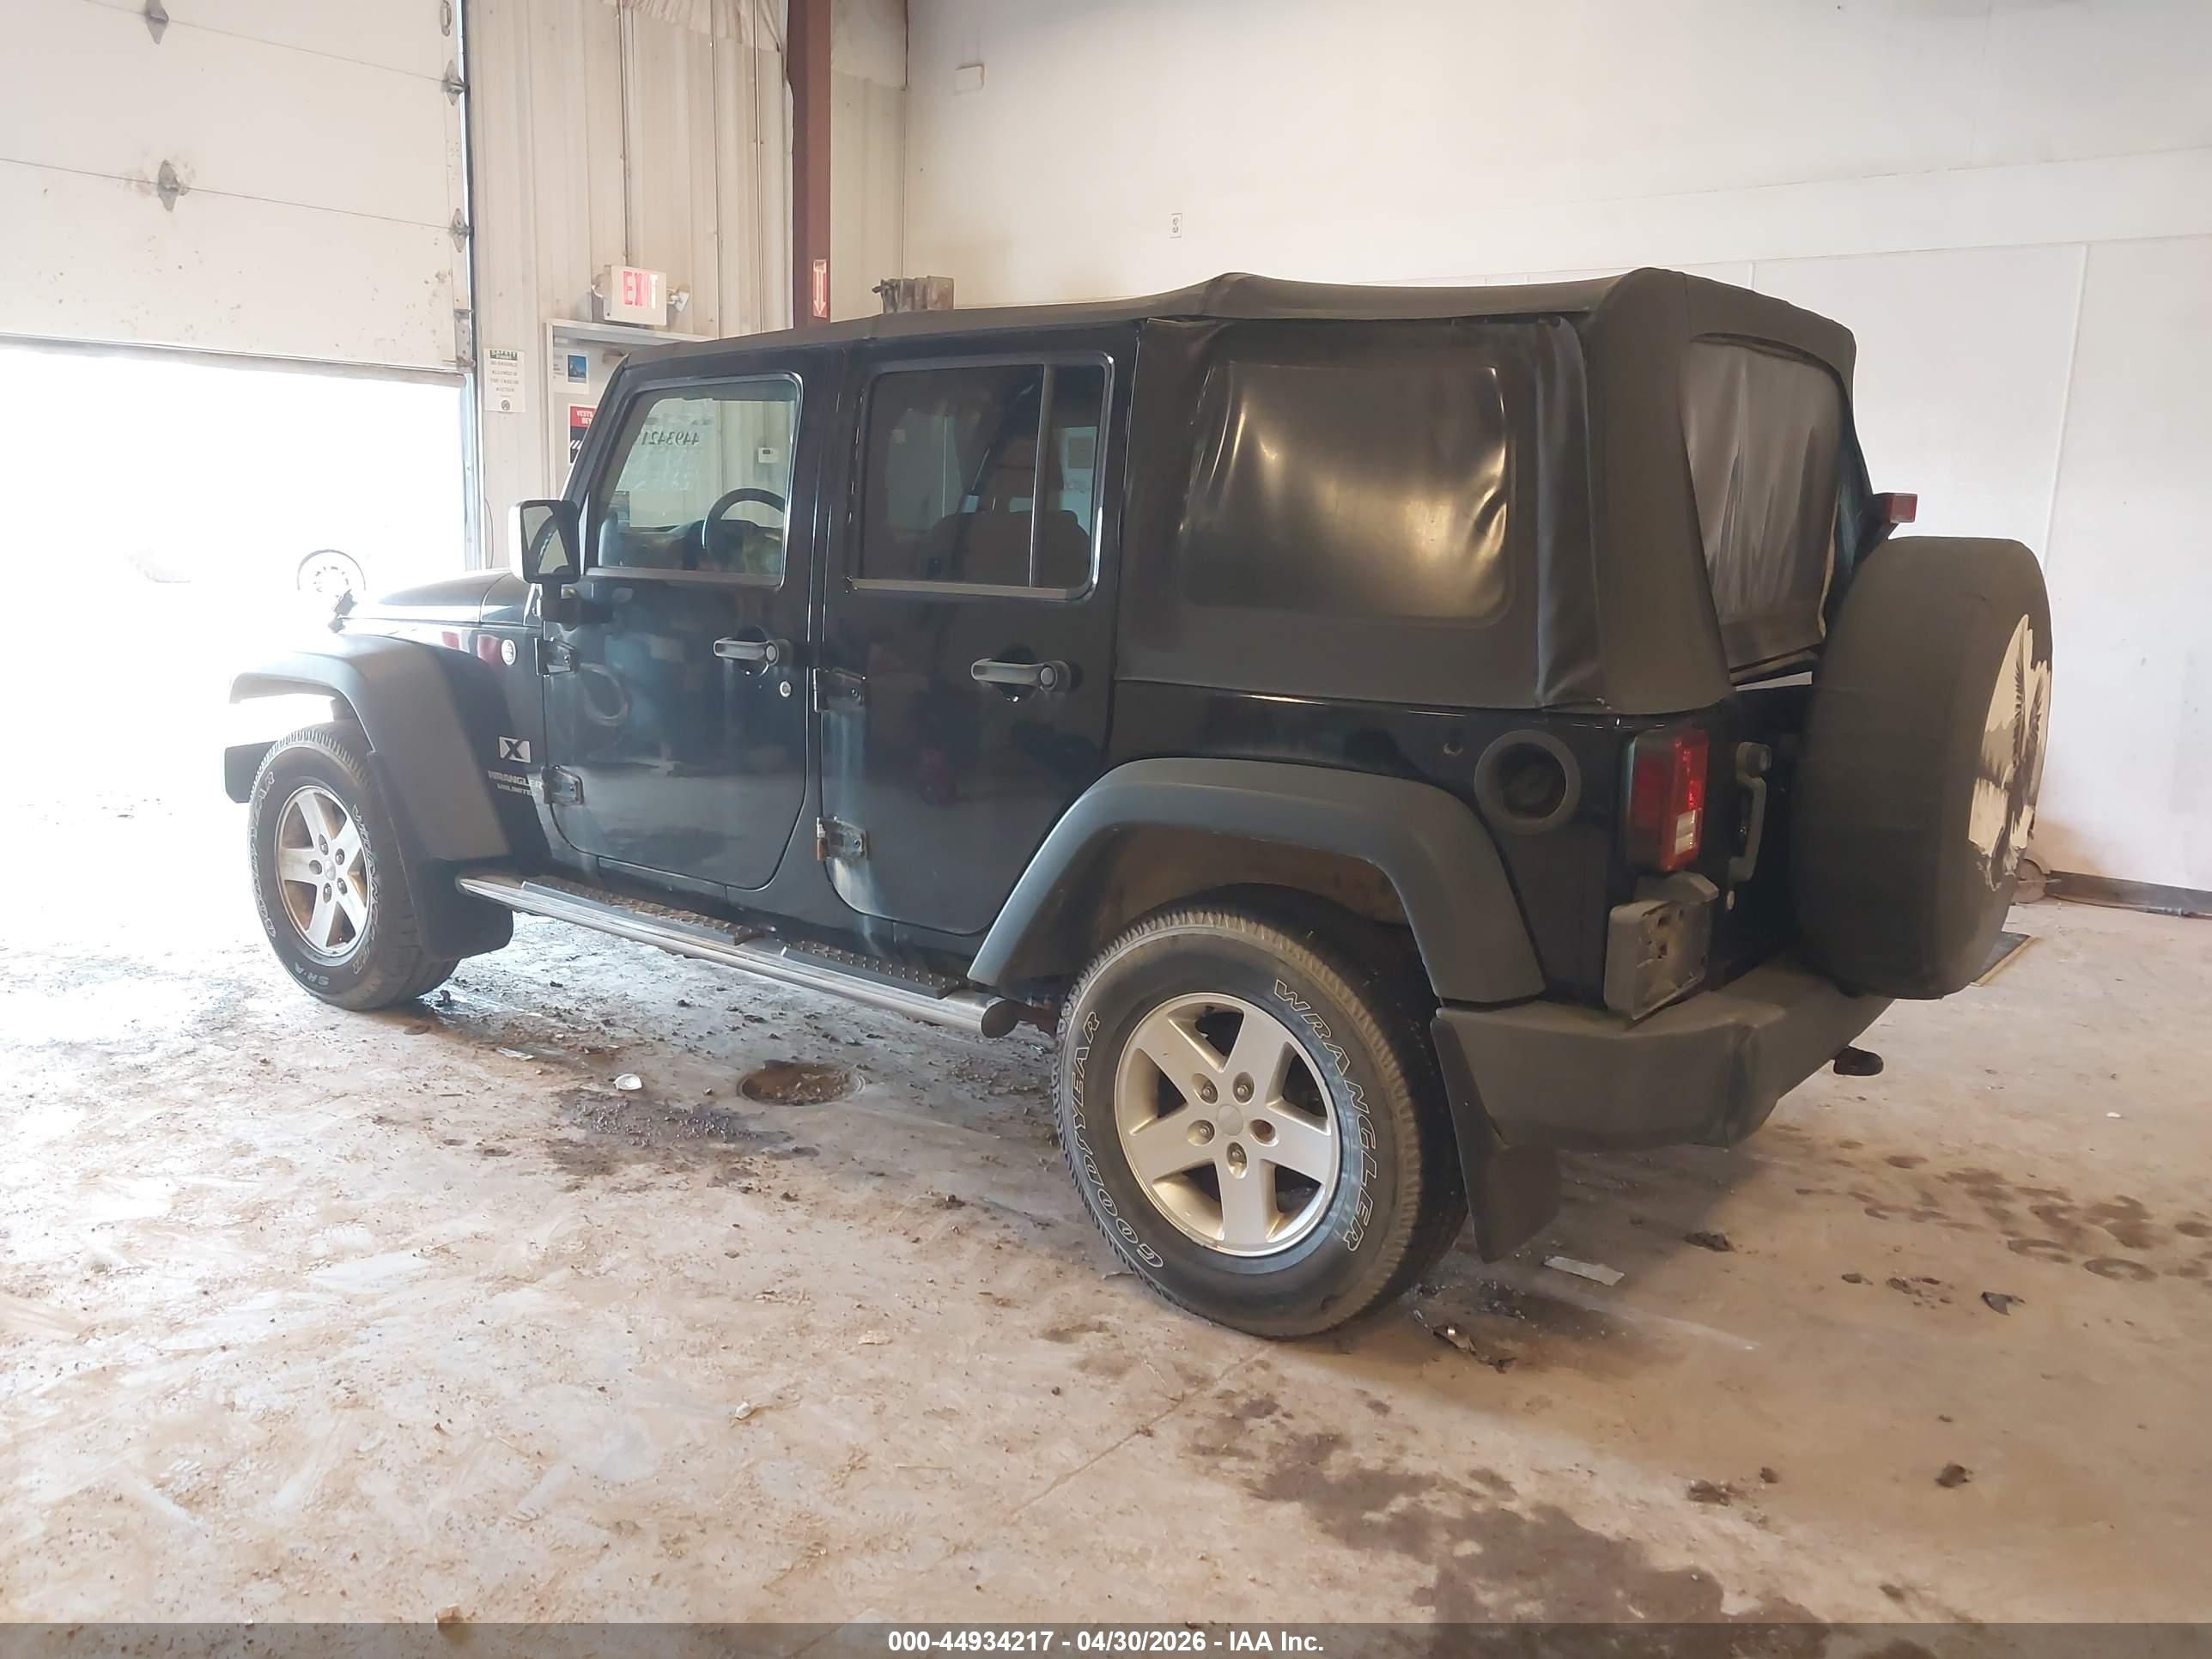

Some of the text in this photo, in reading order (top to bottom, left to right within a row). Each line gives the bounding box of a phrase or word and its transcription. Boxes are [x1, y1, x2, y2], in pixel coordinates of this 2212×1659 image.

[623, 270, 659, 309] EXIT
[501, 738, 526, 762] X
[1071, 1011, 1165, 1268] GOODYEAR
[1273, 979, 1377, 1252] WRANGLER
